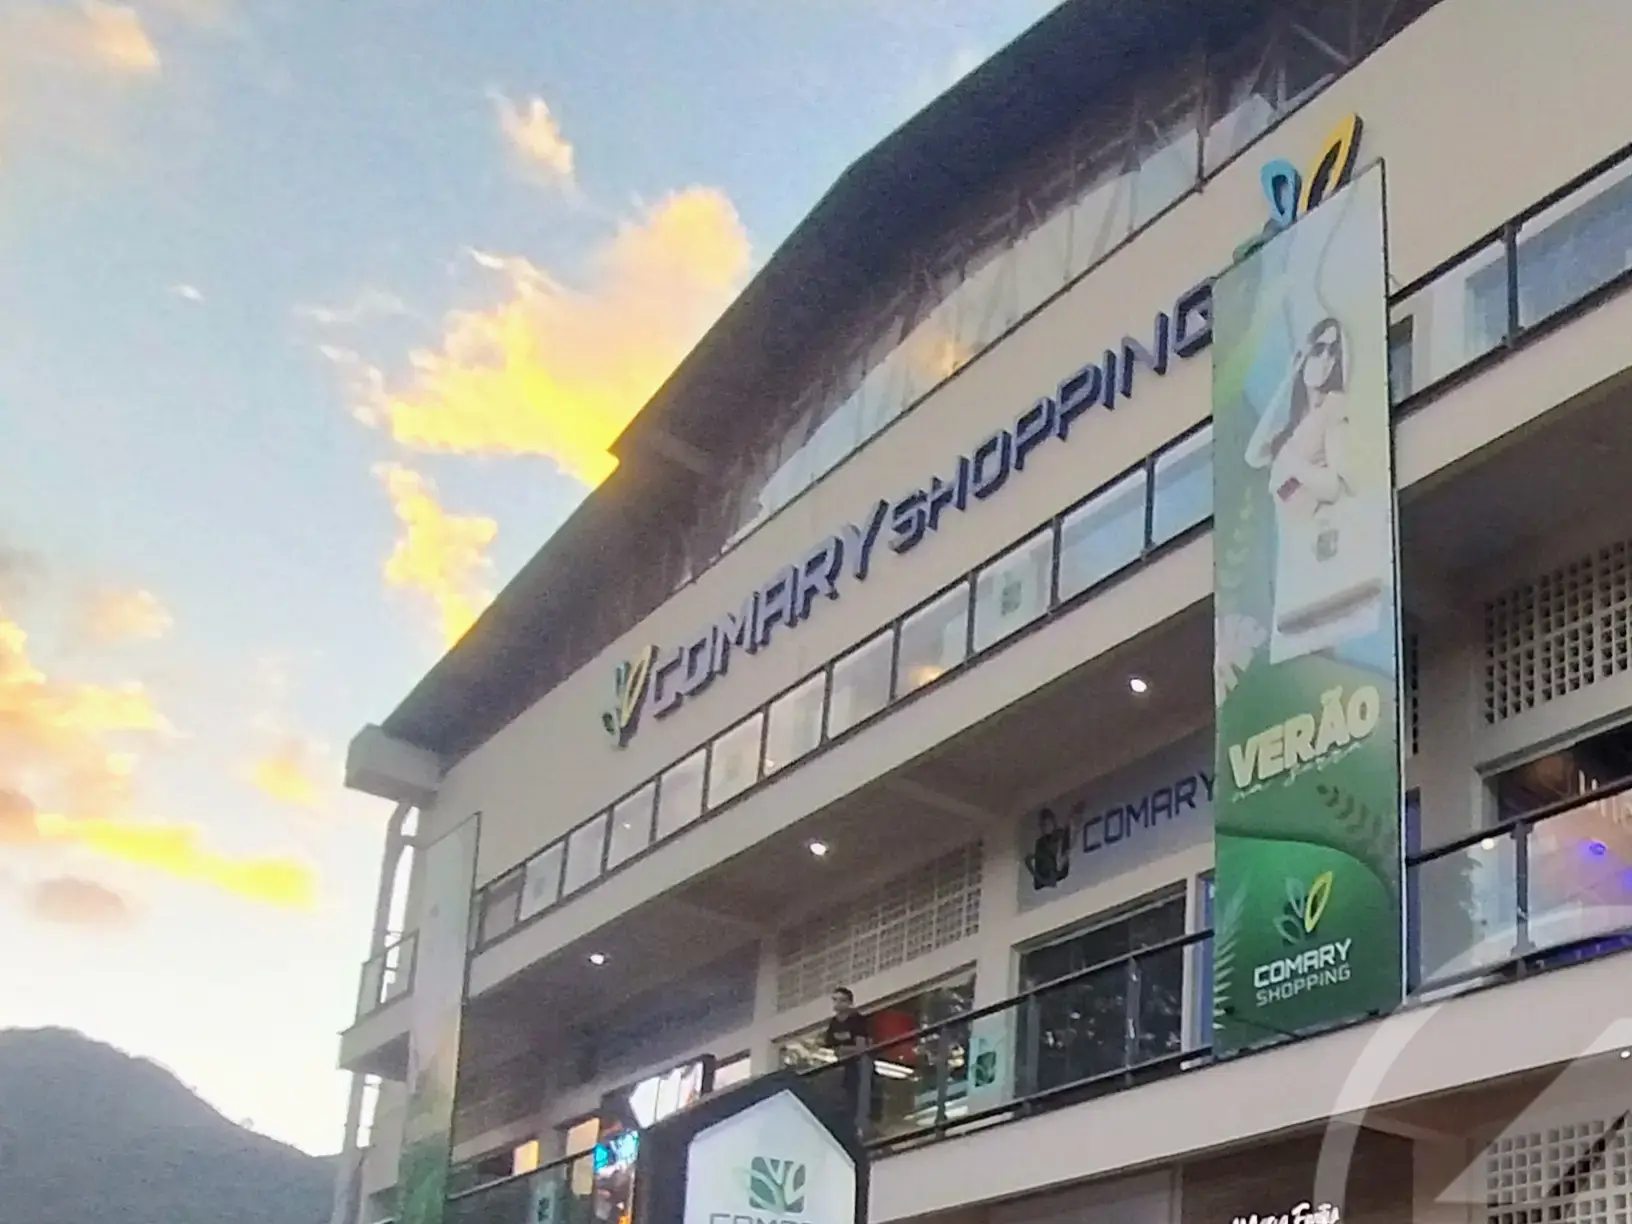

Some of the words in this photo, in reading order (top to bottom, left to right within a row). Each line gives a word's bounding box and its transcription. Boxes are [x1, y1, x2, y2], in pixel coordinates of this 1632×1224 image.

[647, 498, 889, 720] COMARY
[886, 277, 1213, 554] SHOPPING
[1228, 684, 1380, 789] VERÃO
[1082, 769, 1215, 854] COMARY
[1253, 937, 1352, 988] COMARY
[1255, 961, 1352, 1008] SHOPPING
